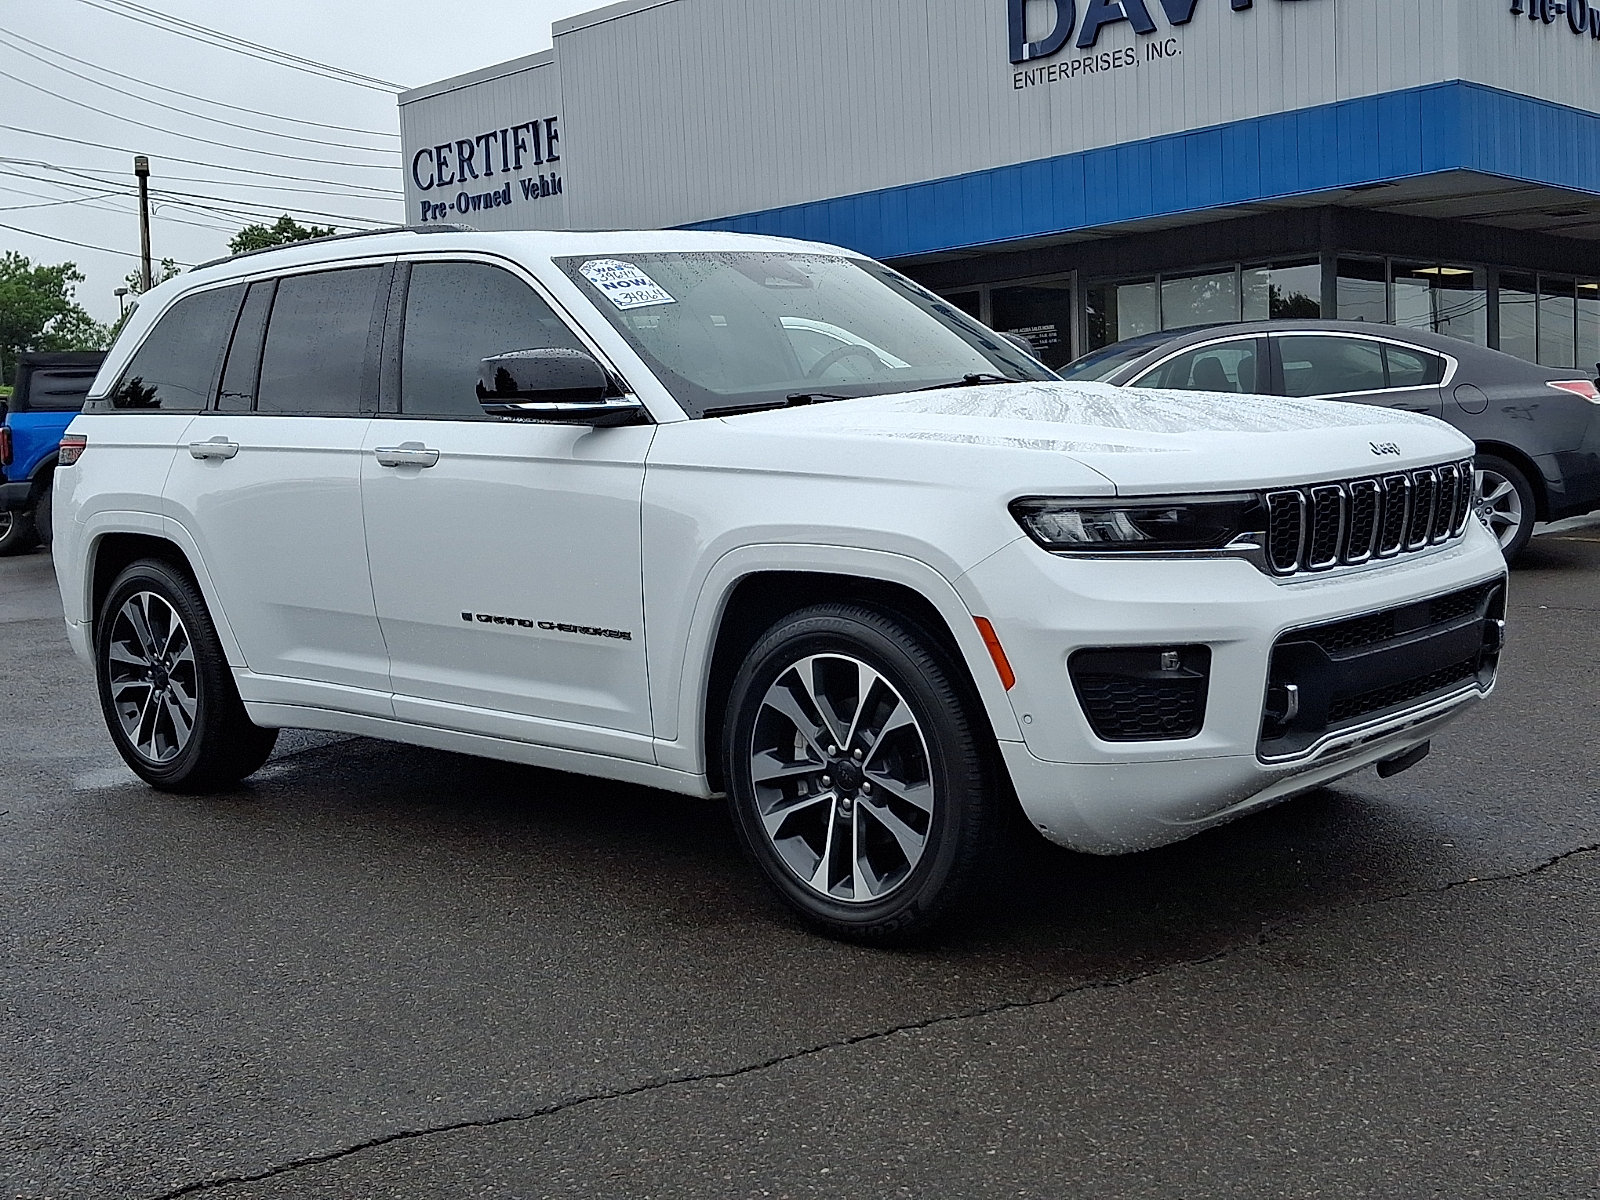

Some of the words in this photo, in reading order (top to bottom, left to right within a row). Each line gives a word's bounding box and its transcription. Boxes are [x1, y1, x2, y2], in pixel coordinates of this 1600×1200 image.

[1012, 48, 1141, 90] ENTERPRISES,
[1146, 38, 1183, 62] INC.
[412, 115, 561, 191] CERTIFIE
[420, 181, 513, 222] Pre-Owned
[602, 278, 647, 290] NOW
[1369, 441, 1400, 456] Jeep
[476, 613, 534, 629] GRAND
[537, 621, 632, 641] CHEROKEE
